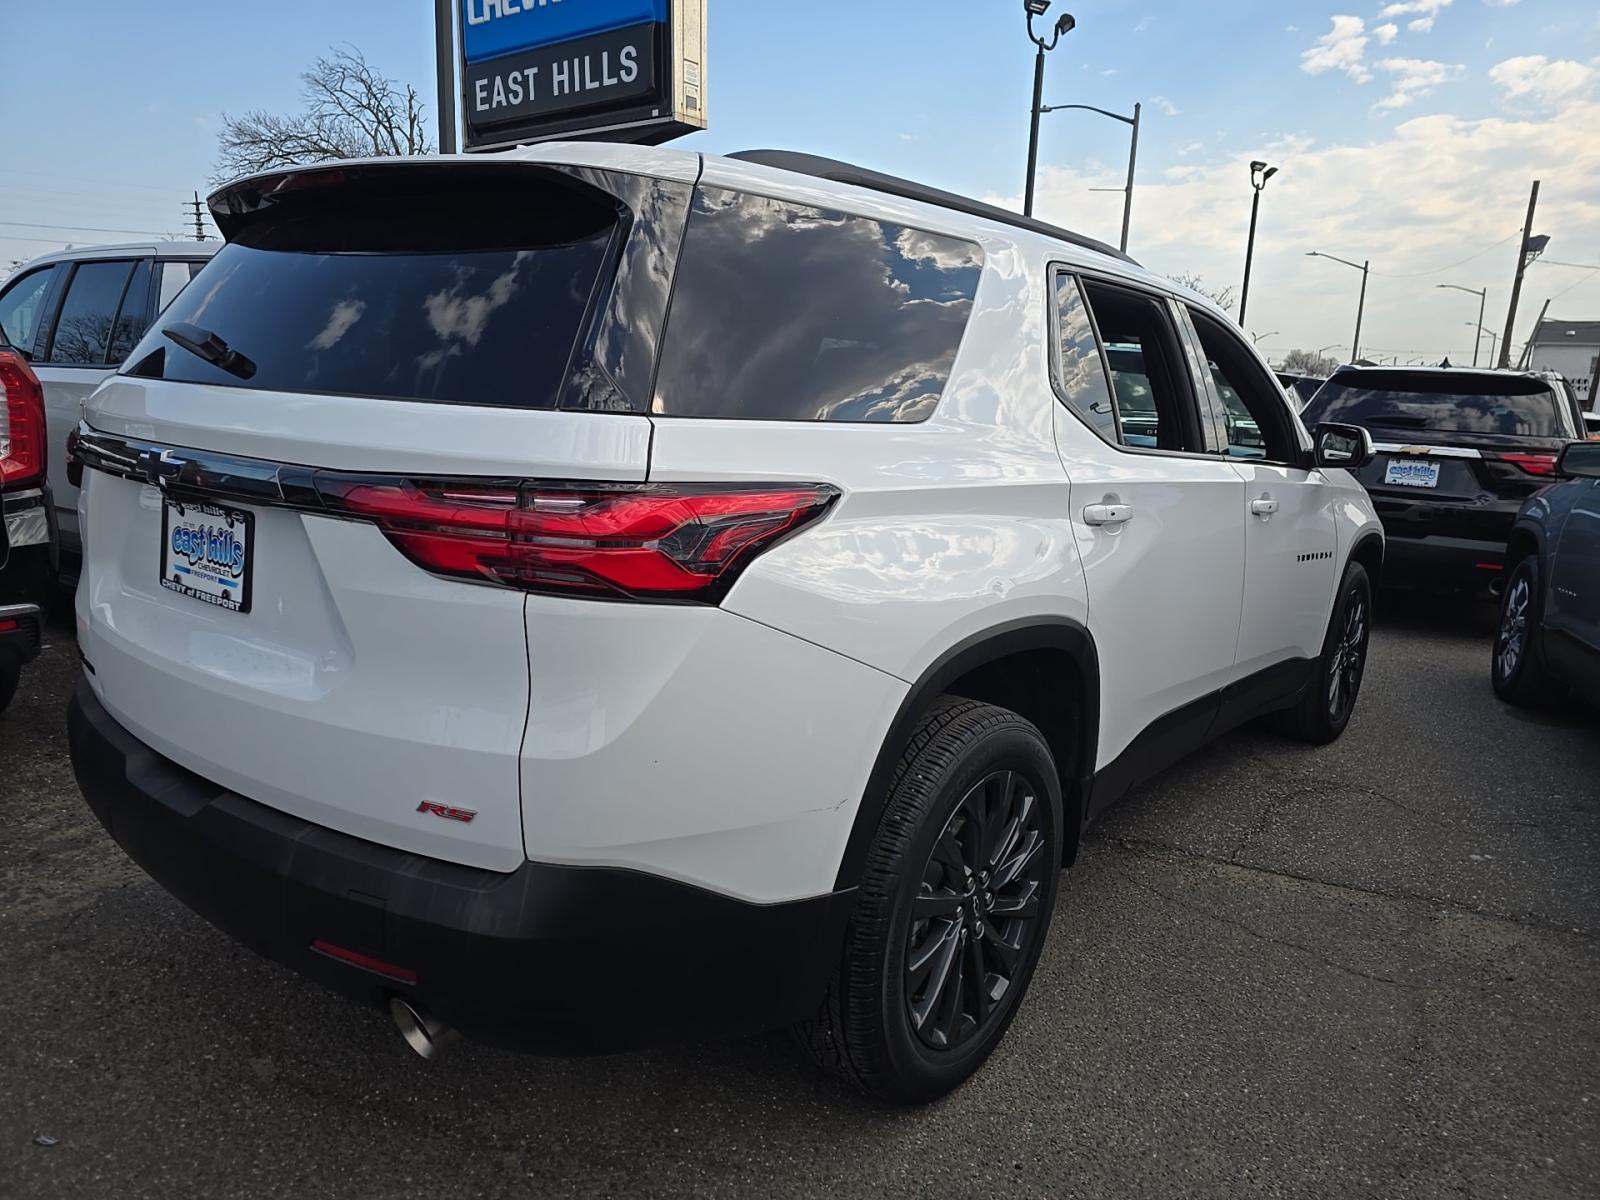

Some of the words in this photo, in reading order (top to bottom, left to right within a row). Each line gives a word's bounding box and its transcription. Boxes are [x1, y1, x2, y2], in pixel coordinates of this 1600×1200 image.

[475, 67, 539, 111] EAST
[552, 45, 639, 96] HILLS
[203, 504, 226, 517] hills
[172, 524, 205, 566] east
[206, 525, 244, 579] hills
[198, 562, 231, 576] CHEVROLET
[162, 578, 186, 594] CHEVY
[196, 590, 241, 611] FREEPORT
[416, 800, 478, 823] RS
